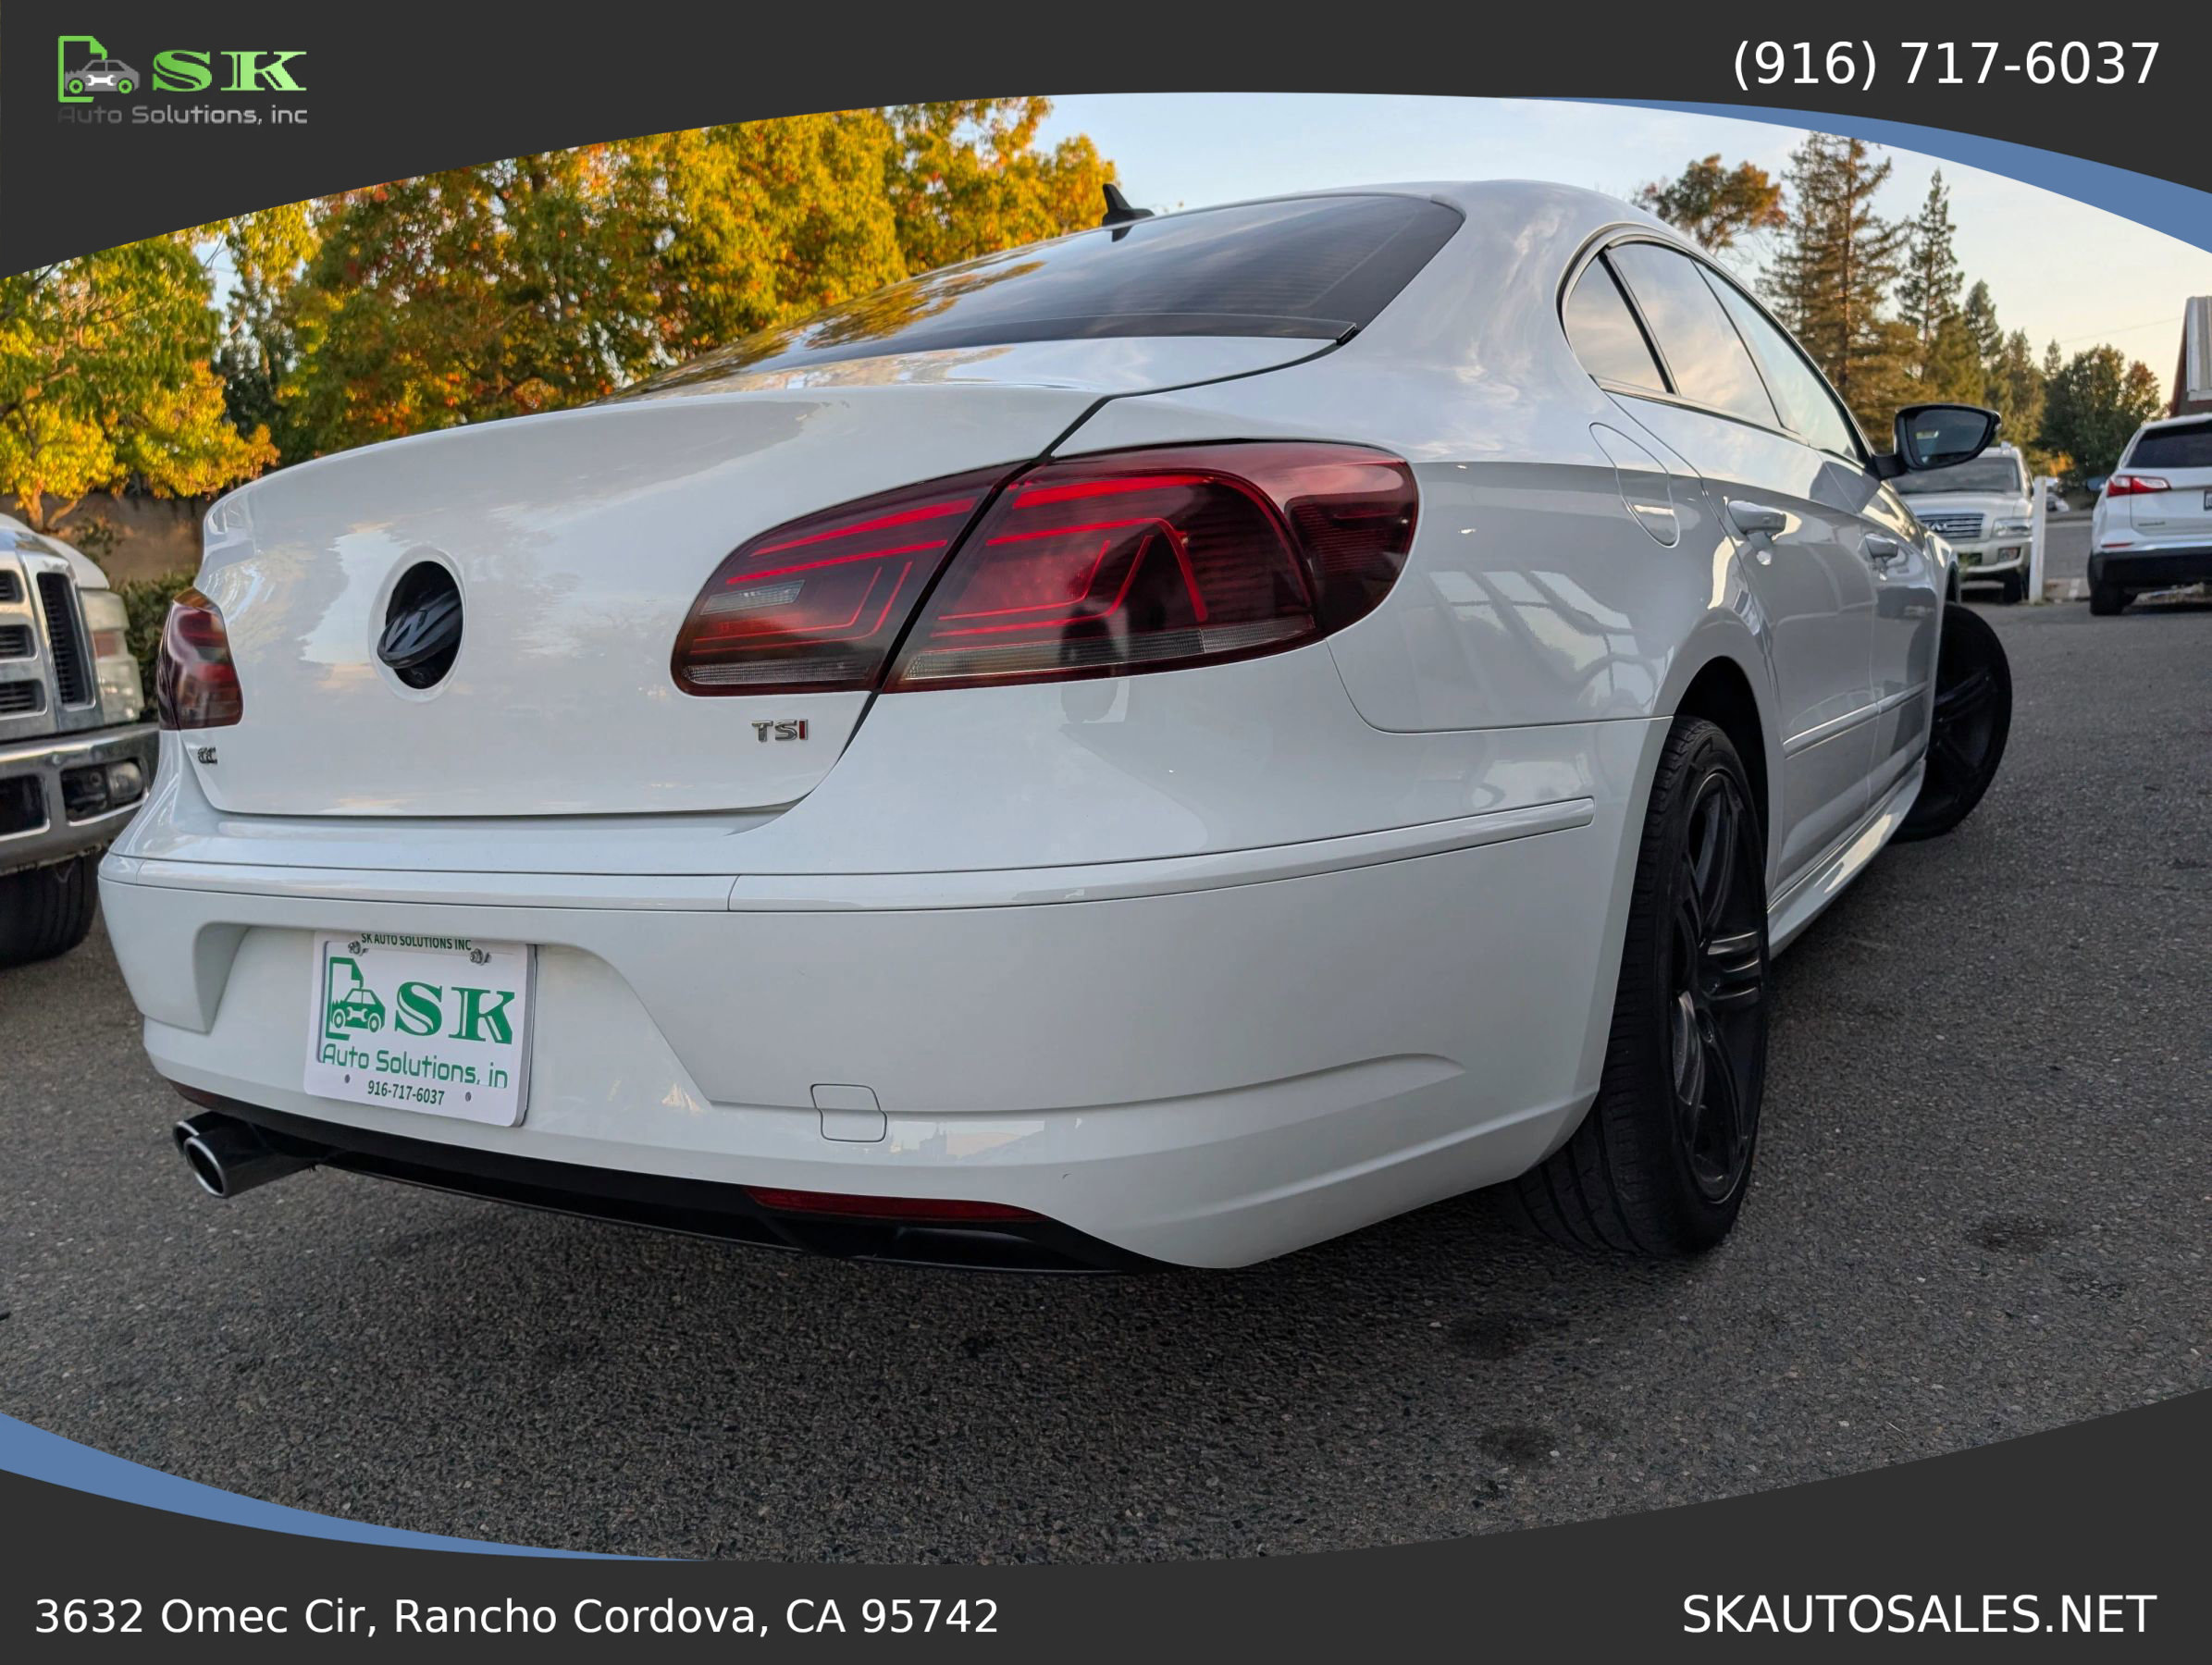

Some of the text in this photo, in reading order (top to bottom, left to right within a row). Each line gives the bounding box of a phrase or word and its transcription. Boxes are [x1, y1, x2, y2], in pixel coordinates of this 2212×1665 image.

[751, 719, 809, 742] TSI
[361, 933, 472, 951] SK AUTO SOLUTIONS INC
[394, 980, 515, 1044] SK
[323, 1042, 370, 1070] Auto
[375, 1049, 481, 1086] Solutions,
[367, 1079, 445, 1106] 916-717-6037
